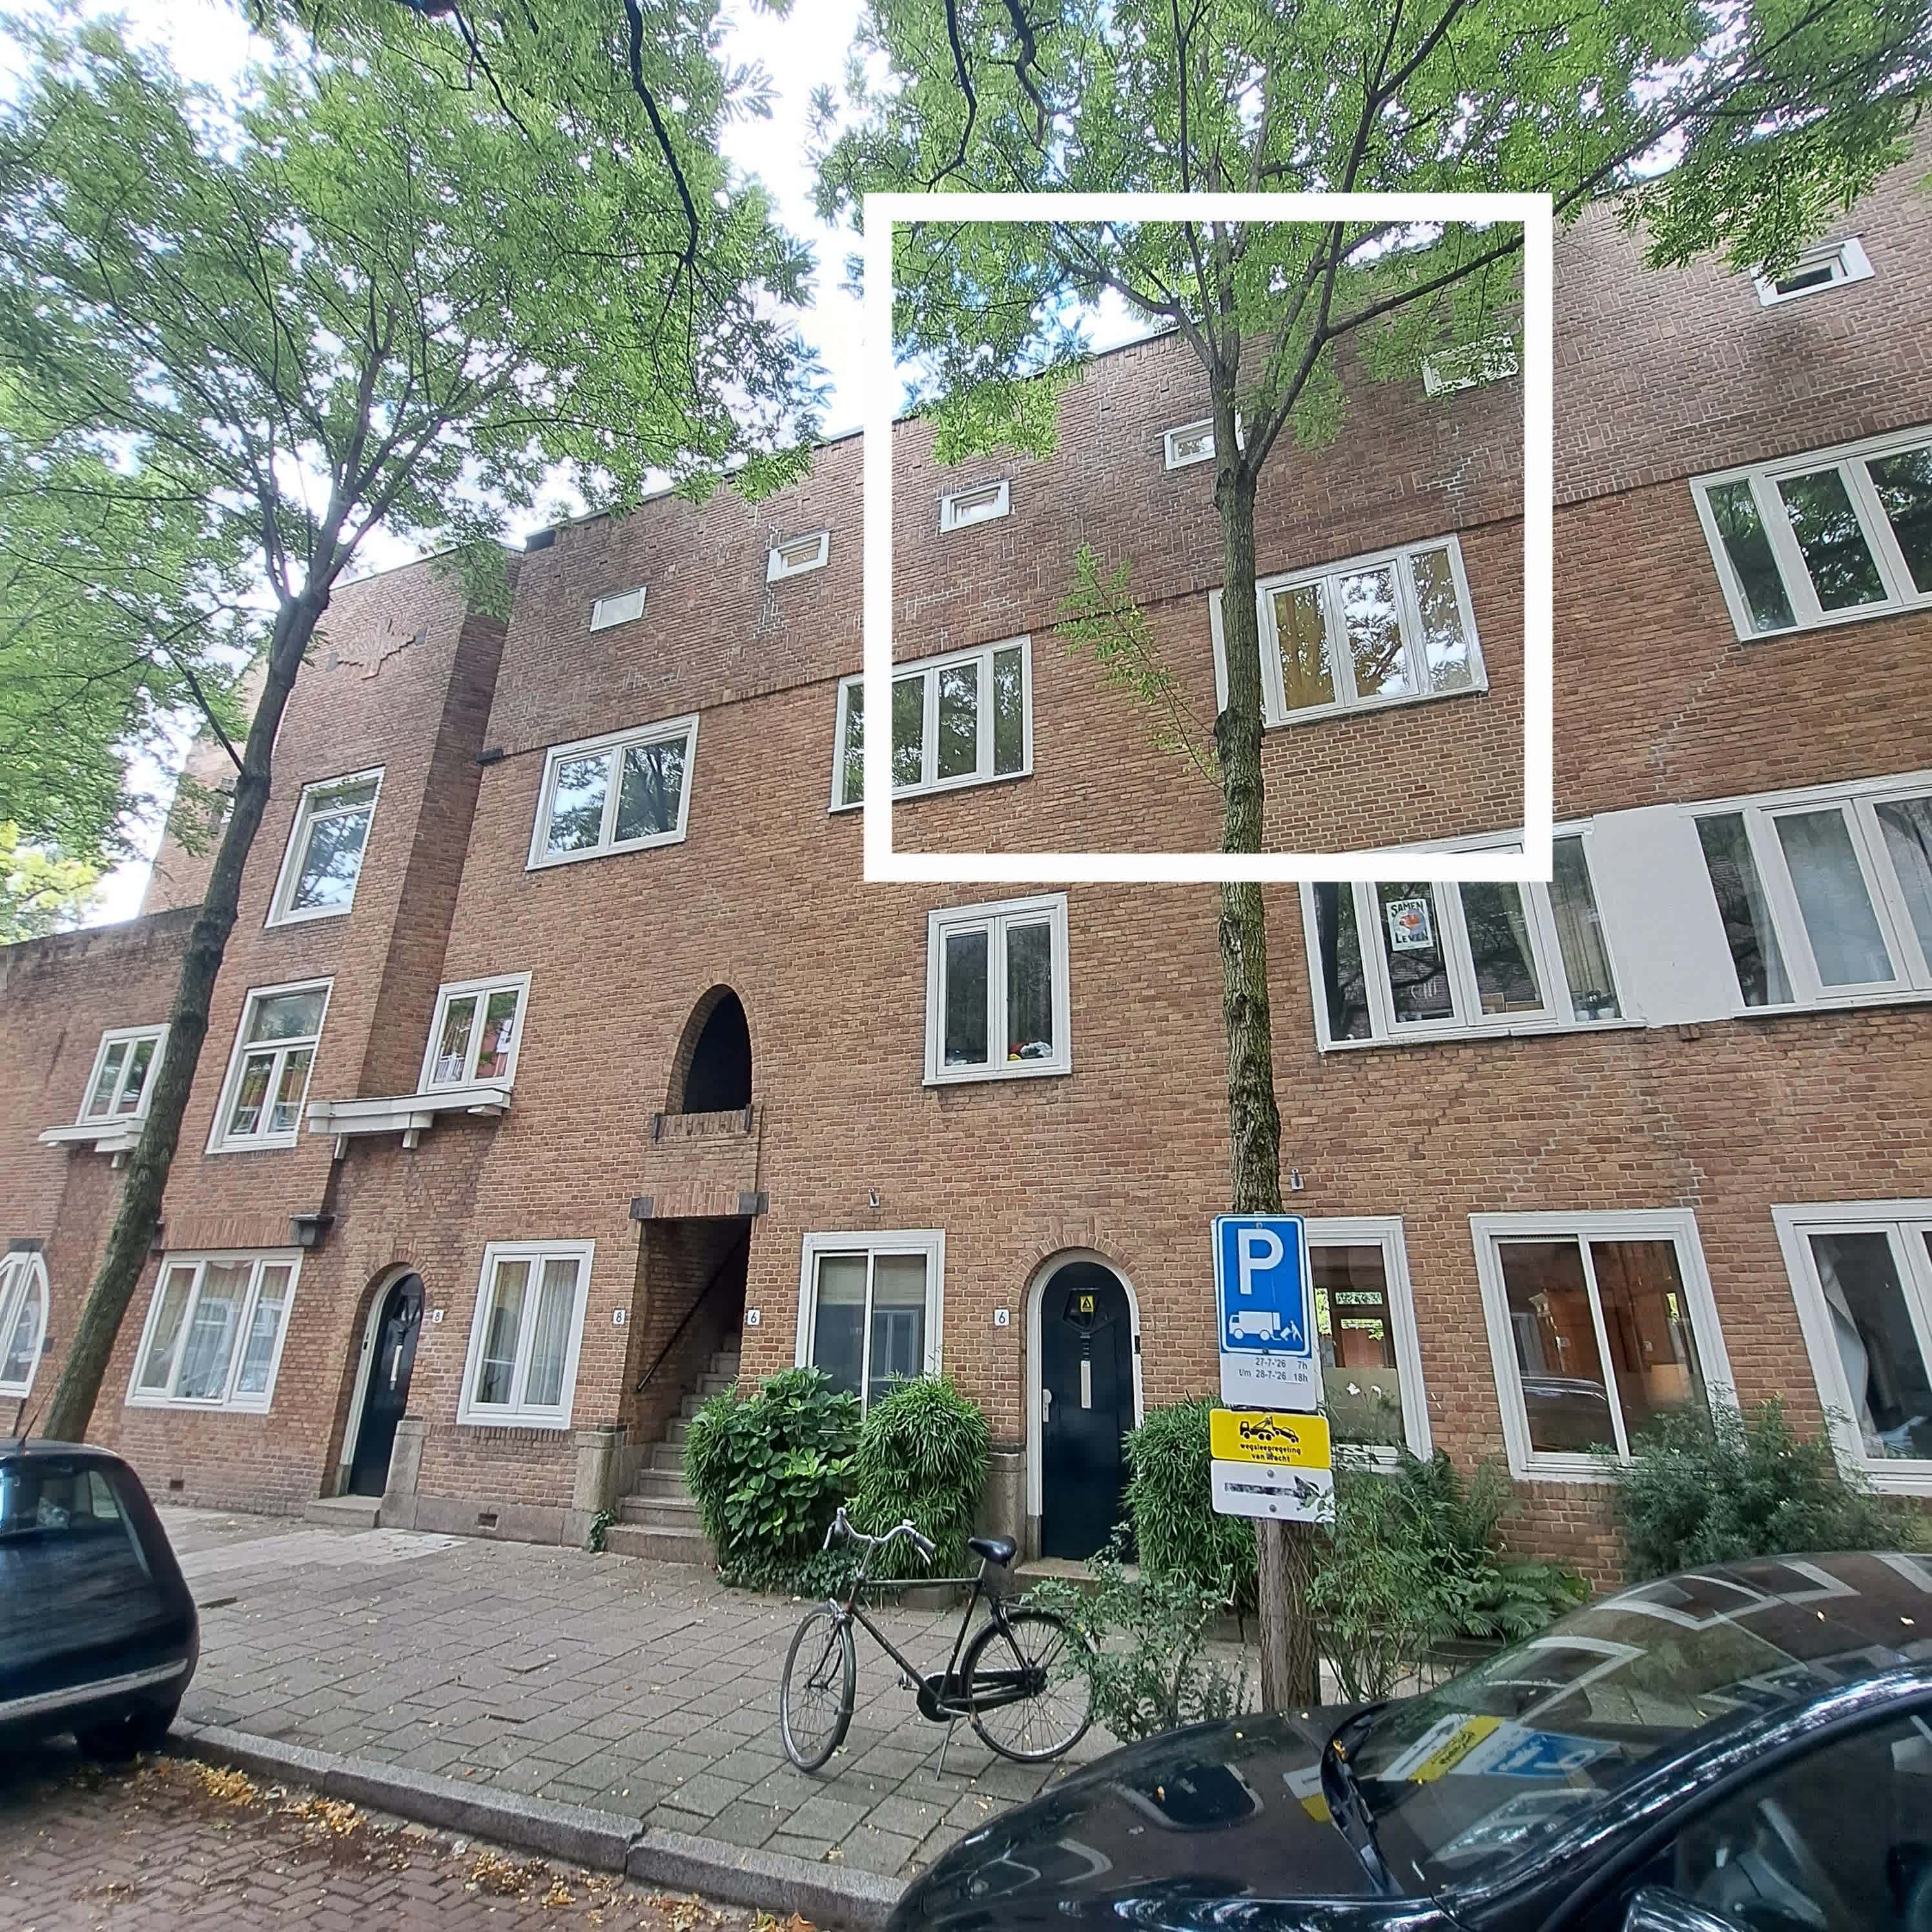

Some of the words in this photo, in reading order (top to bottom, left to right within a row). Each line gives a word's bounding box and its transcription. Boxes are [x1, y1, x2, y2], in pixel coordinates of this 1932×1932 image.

[1391, 901, 1425, 918] SAMEN
[1395, 928, 1429, 943] LEVEN
[1237, 1228, 1284, 1295] P
[435, 1311, 440, 1322] 8
[615, 1311, 622, 1322] 8
[750, 1311, 757, 1323] 6
[998, 1311, 1006, 1324] 6
[1297, 1361, 1308, 1370] 7h
[1293, 1373, 1308, 1382] 18h
[1240, 1443, 1301, 1456] wegsleepregeling
